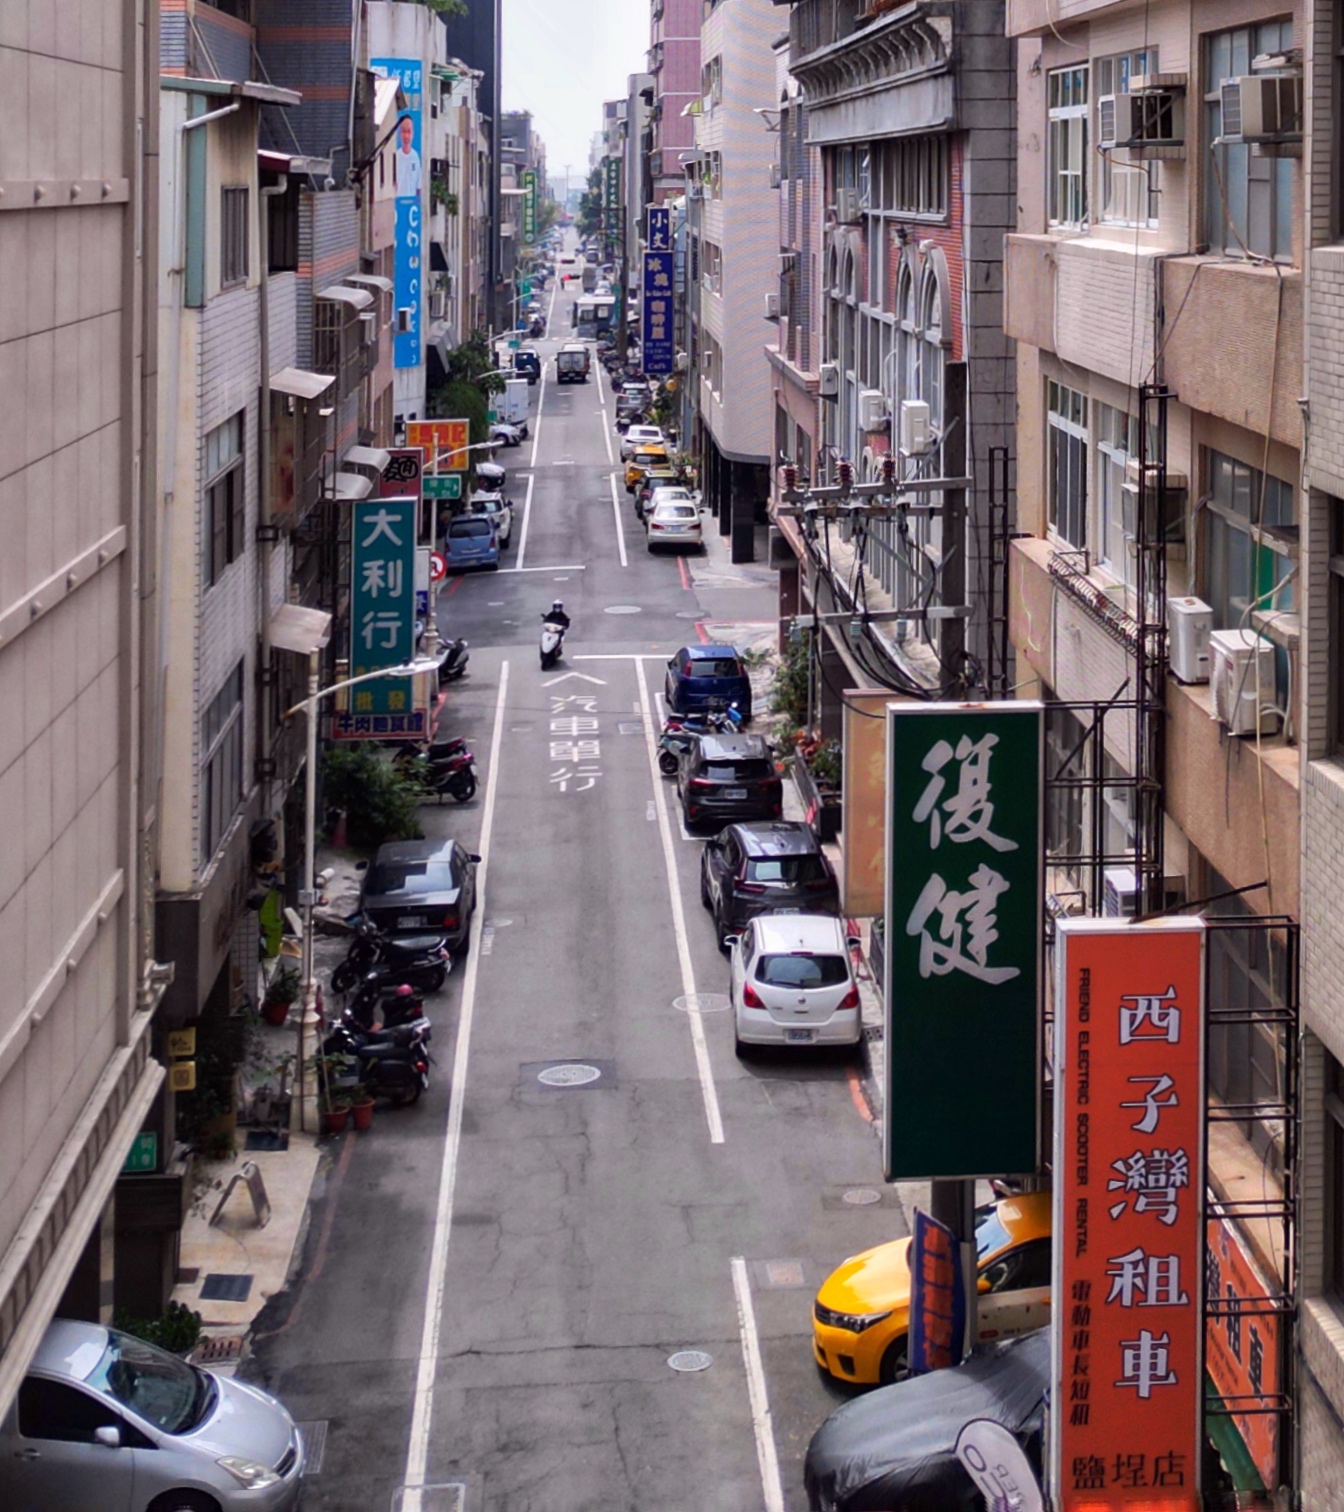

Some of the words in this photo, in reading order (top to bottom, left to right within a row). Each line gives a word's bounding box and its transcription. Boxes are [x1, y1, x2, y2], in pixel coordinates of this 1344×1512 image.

[651, 212, 668, 249] 小文
[361, 508, 403, 650] 大利行
[549, 695, 603, 792] 汽車單行
[905, 732, 1021, 985] 復健
[1078, 967, 1091, 1023] FRIEND
[1077, 1030, 1090, 1106] ELECTRIC
[1076, 1112, 1090, 1186] SCOOTER
[1075, 1197, 1088, 1258] RENTAL
[1105, 984, 1190, 1399] 西子灣租車
[1070, 1279, 1091, 1426] 電動車長短租
[1072, 1449, 1187, 1490] 鹽埕店
